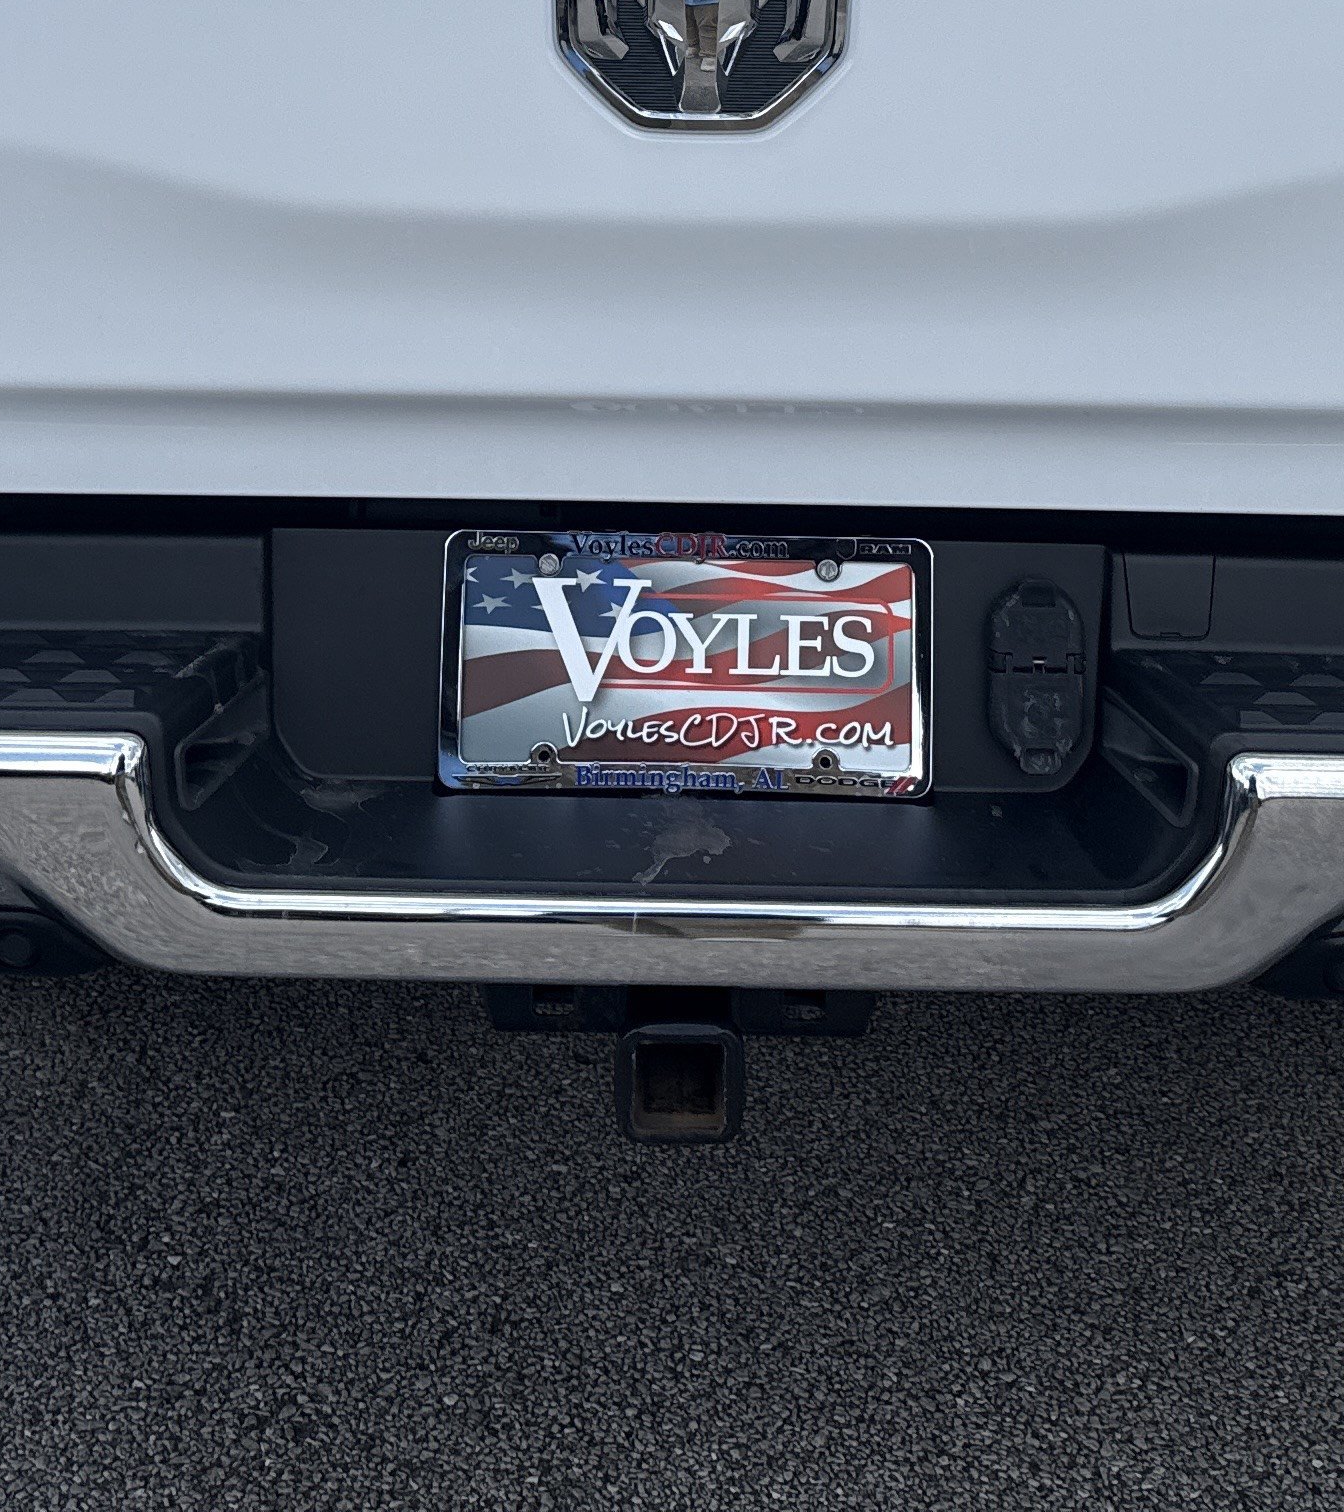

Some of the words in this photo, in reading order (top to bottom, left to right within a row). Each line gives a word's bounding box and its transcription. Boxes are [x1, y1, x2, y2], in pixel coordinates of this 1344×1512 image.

[468, 530, 519, 555] Jeep
[568, 530, 789, 564] VoylesCDJR.com
[859, 543, 912, 556] RAM
[532, 577, 875, 703] VOYLES
[574, 762, 745, 794] Birmingham,
[753, 767, 791, 790] AL
[794, 774, 897, 789] DODGE
